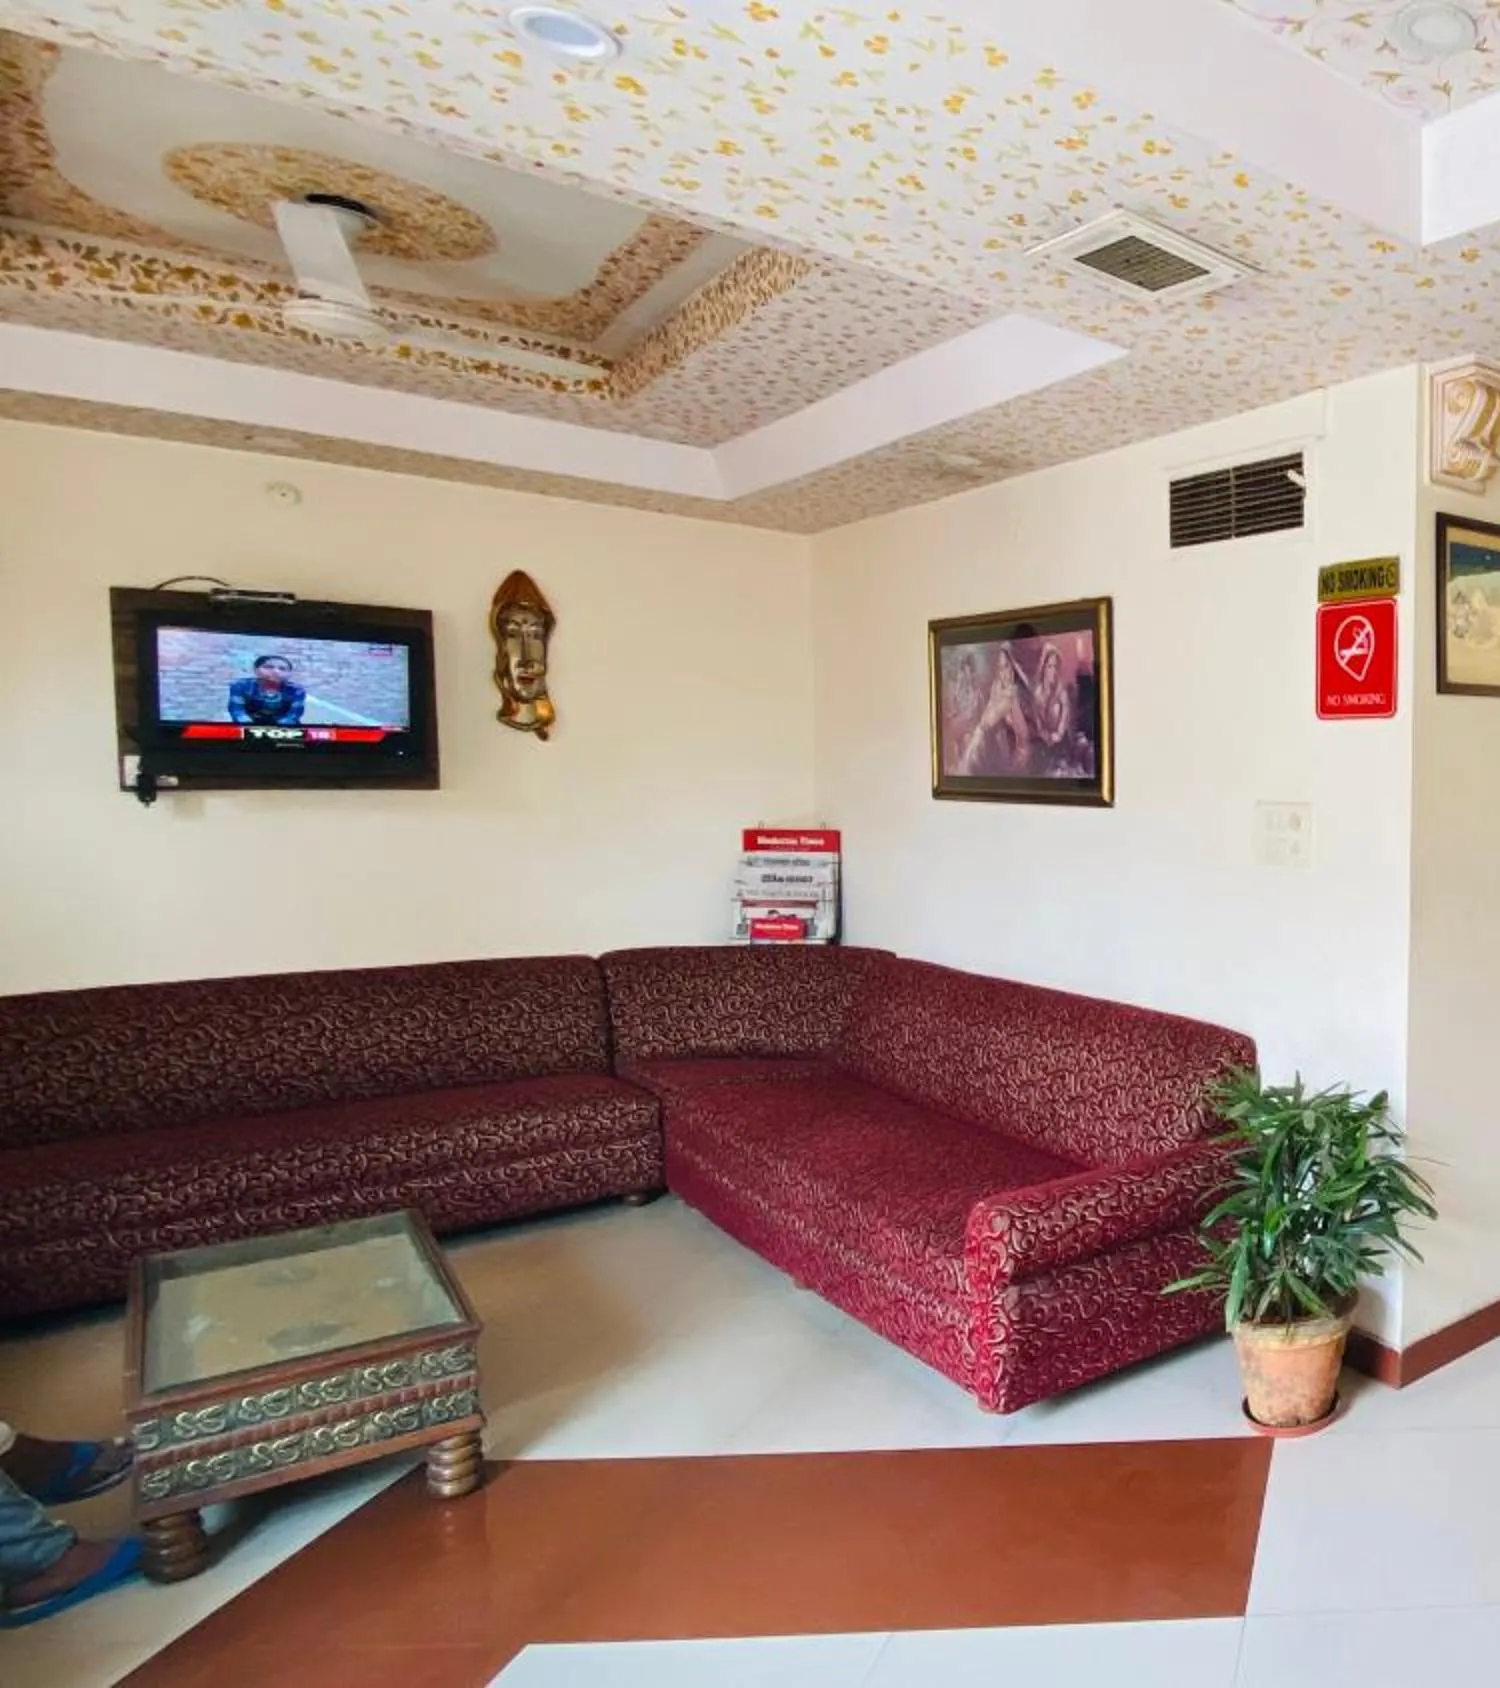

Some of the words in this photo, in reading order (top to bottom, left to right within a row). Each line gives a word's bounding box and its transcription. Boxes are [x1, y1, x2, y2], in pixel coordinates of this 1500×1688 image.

[1319, 571, 1334, 594] NO
[1337, 566, 1385, 593] SMOKING
[1327, 695, 1341, 707] NO
[1342, 692, 1387, 706] SMOKING
[249, 728, 304, 739] TOP
